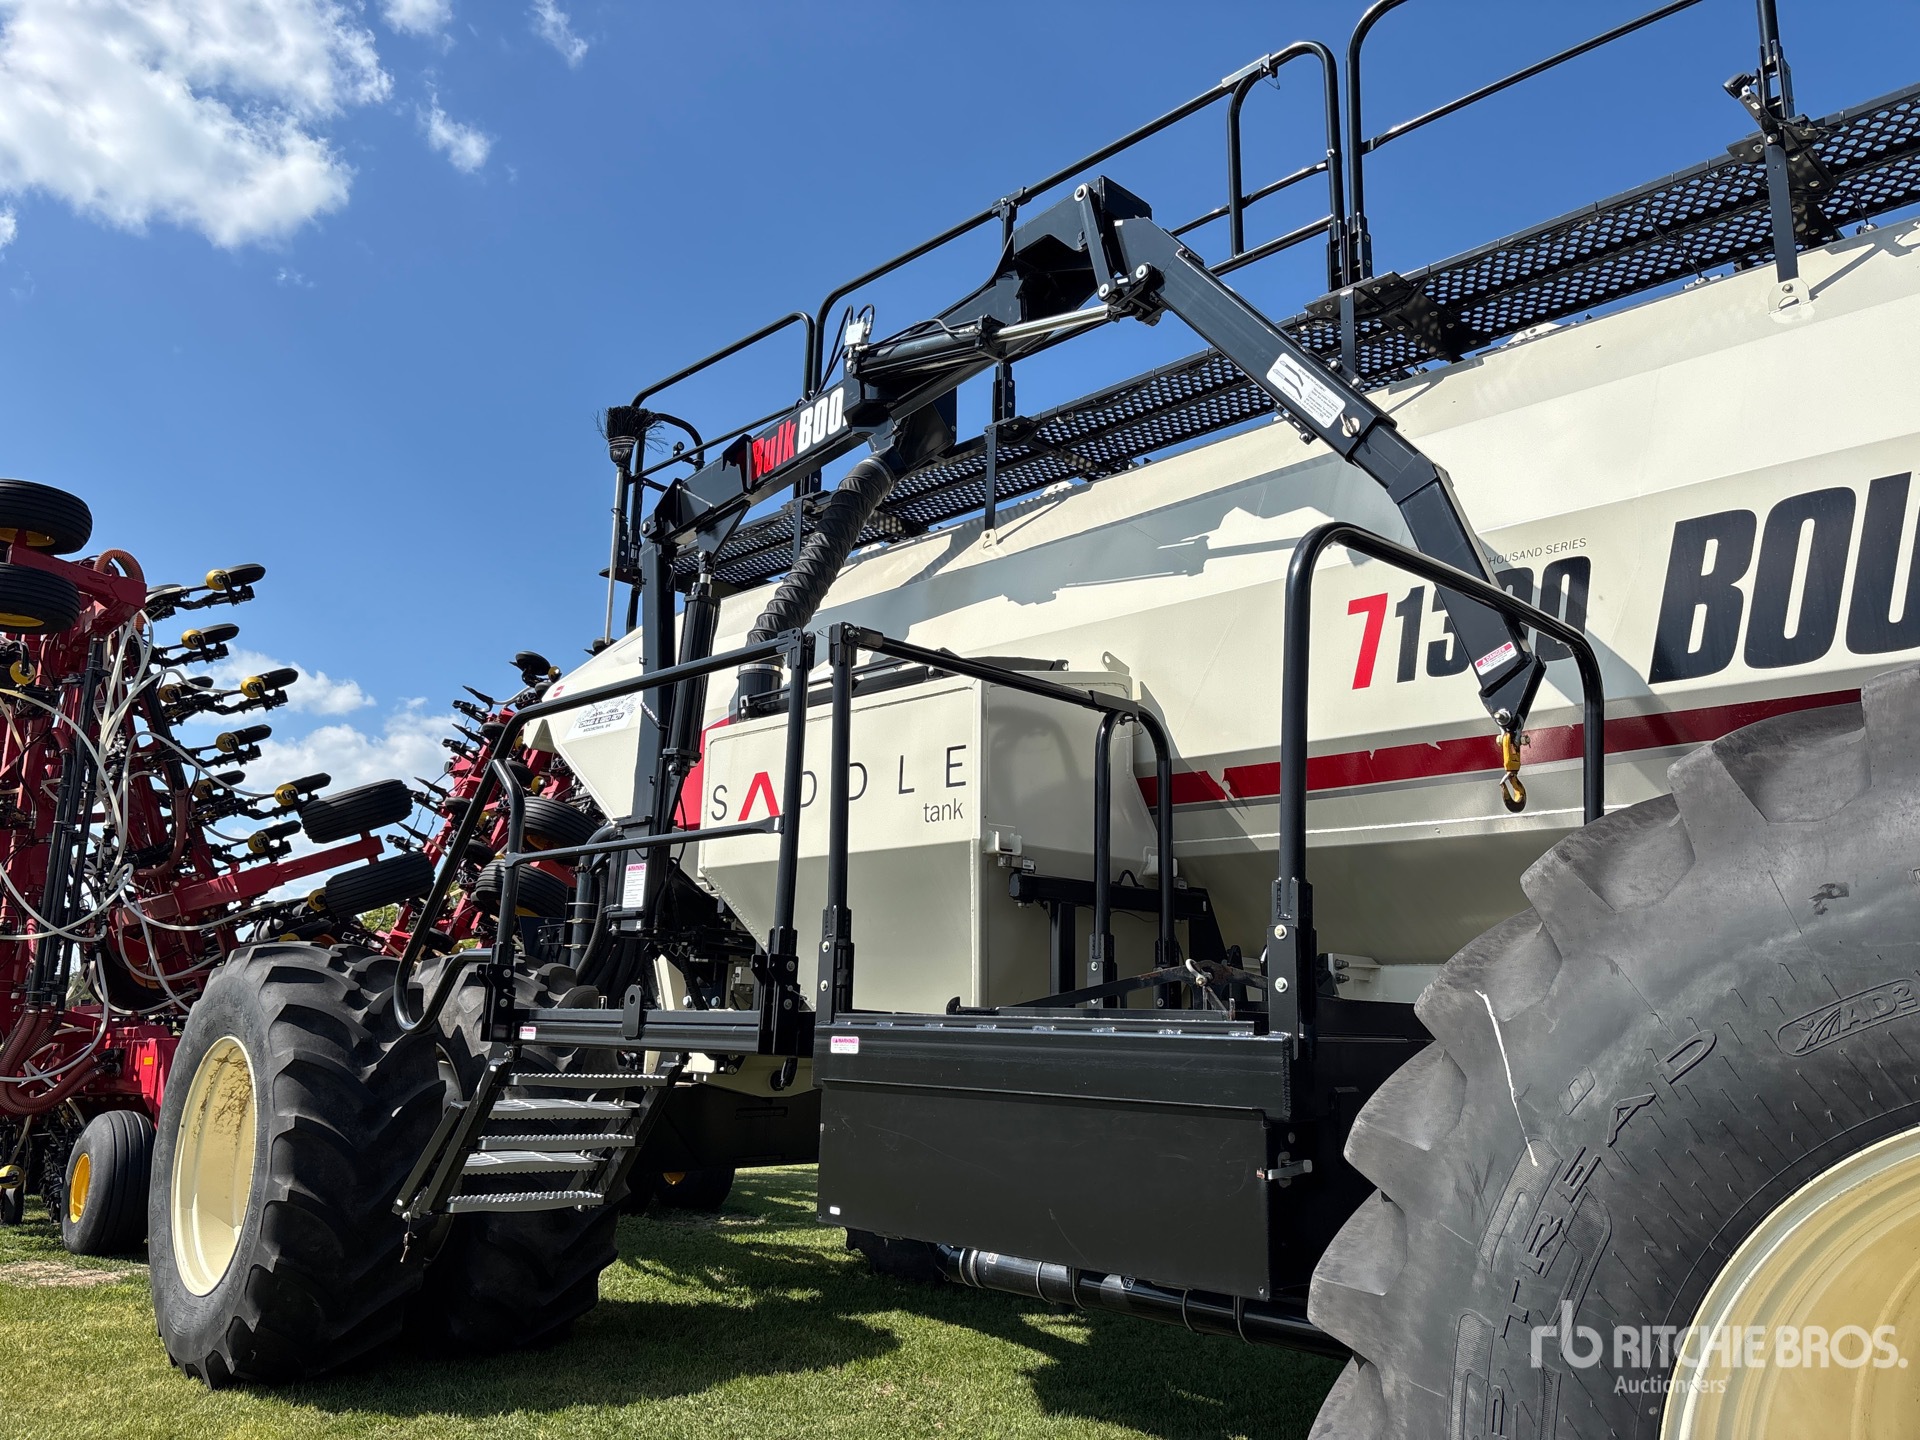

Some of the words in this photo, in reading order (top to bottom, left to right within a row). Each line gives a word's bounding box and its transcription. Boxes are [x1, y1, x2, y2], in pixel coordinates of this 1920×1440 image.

[752, 419, 797, 480] Bulk
[797, 386, 848, 455] BOO
[1487, 547, 1543, 566] HOUSAND
[1545, 537, 1587, 555] SERIES
[711, 744, 967, 821] SADDLE
[923, 798, 964, 823] tank
